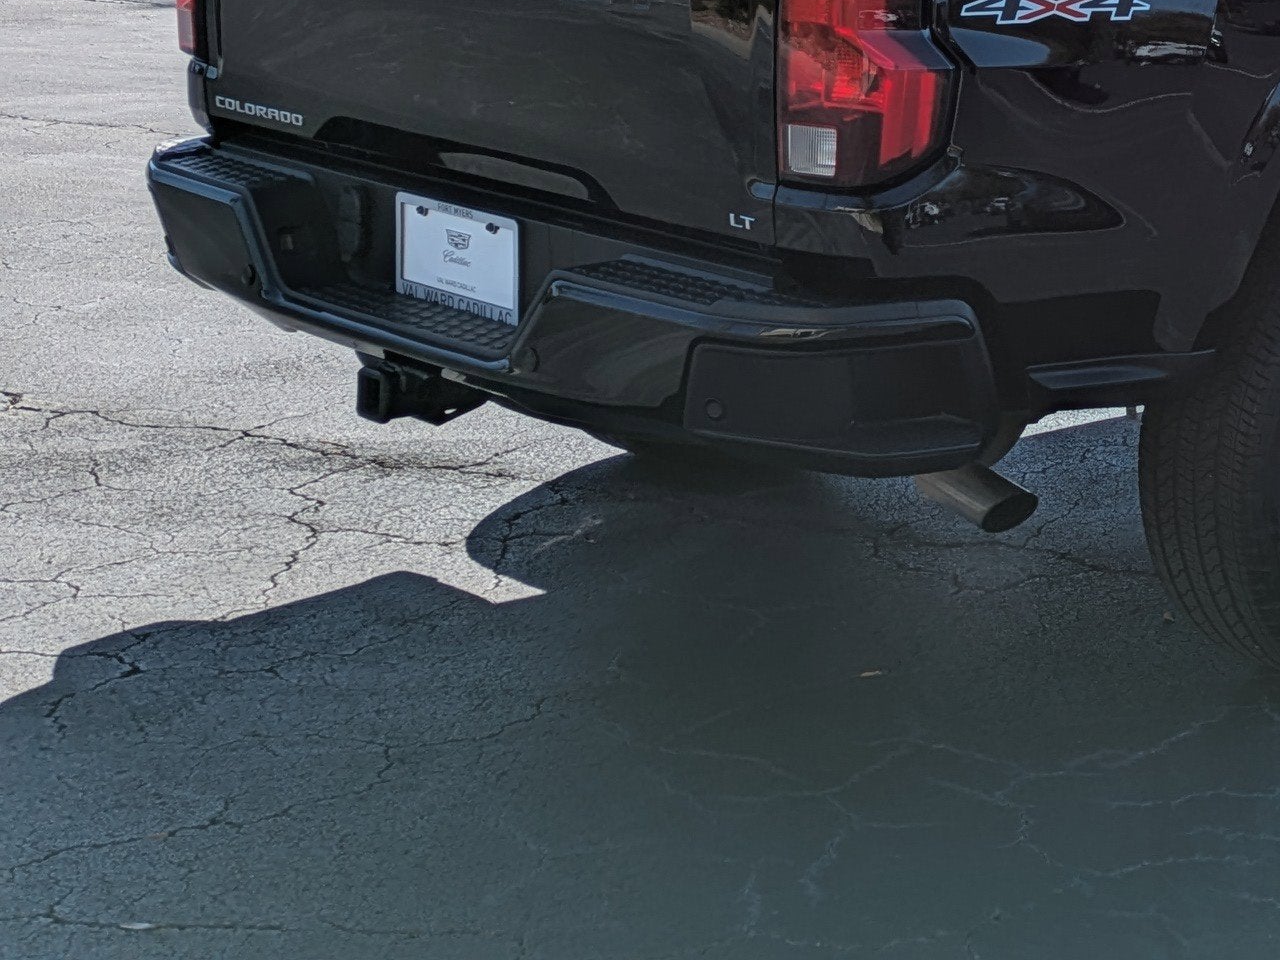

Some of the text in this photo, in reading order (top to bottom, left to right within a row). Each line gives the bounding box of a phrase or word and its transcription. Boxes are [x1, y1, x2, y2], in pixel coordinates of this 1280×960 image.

[215, 95, 304, 126] COLORADO
[453, 206, 474, 220] MYERS
[729, 213, 756, 230] LT
[442, 249, 472, 268] Cadillac
[401, 282, 513, 325] VAL WARD CADILLAC
